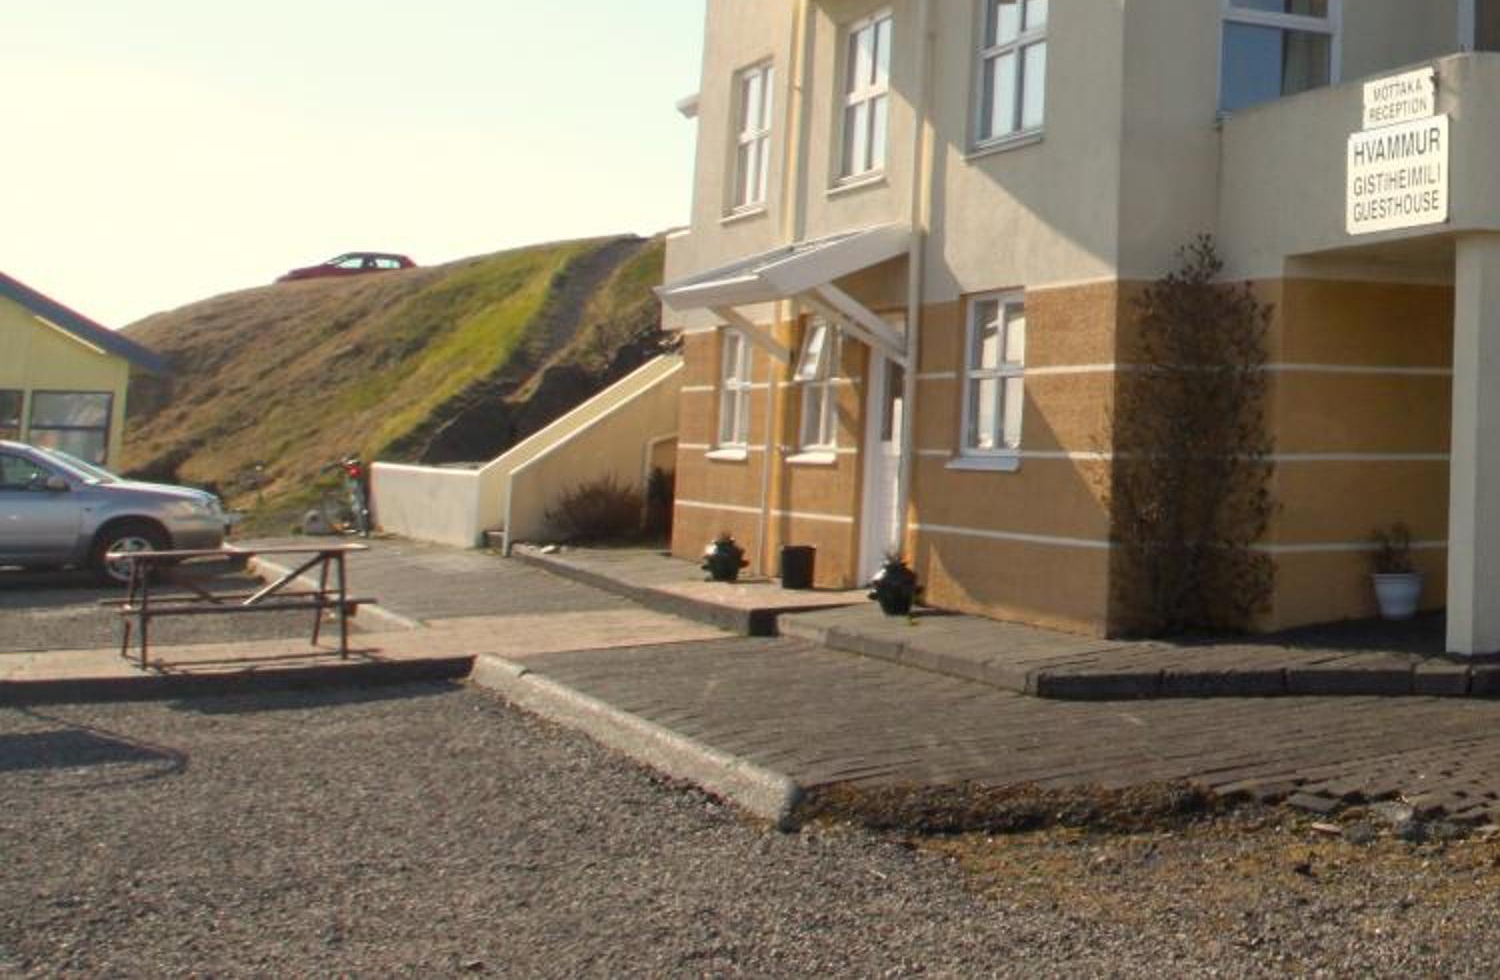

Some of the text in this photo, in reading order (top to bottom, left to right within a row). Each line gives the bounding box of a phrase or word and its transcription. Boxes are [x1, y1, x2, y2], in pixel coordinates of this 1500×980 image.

[1369, 97, 1427, 121] RECEPTION
[1353, 127, 1441, 167] HVAMMUR
[1353, 189, 1440, 222] GUESTHOUSE
